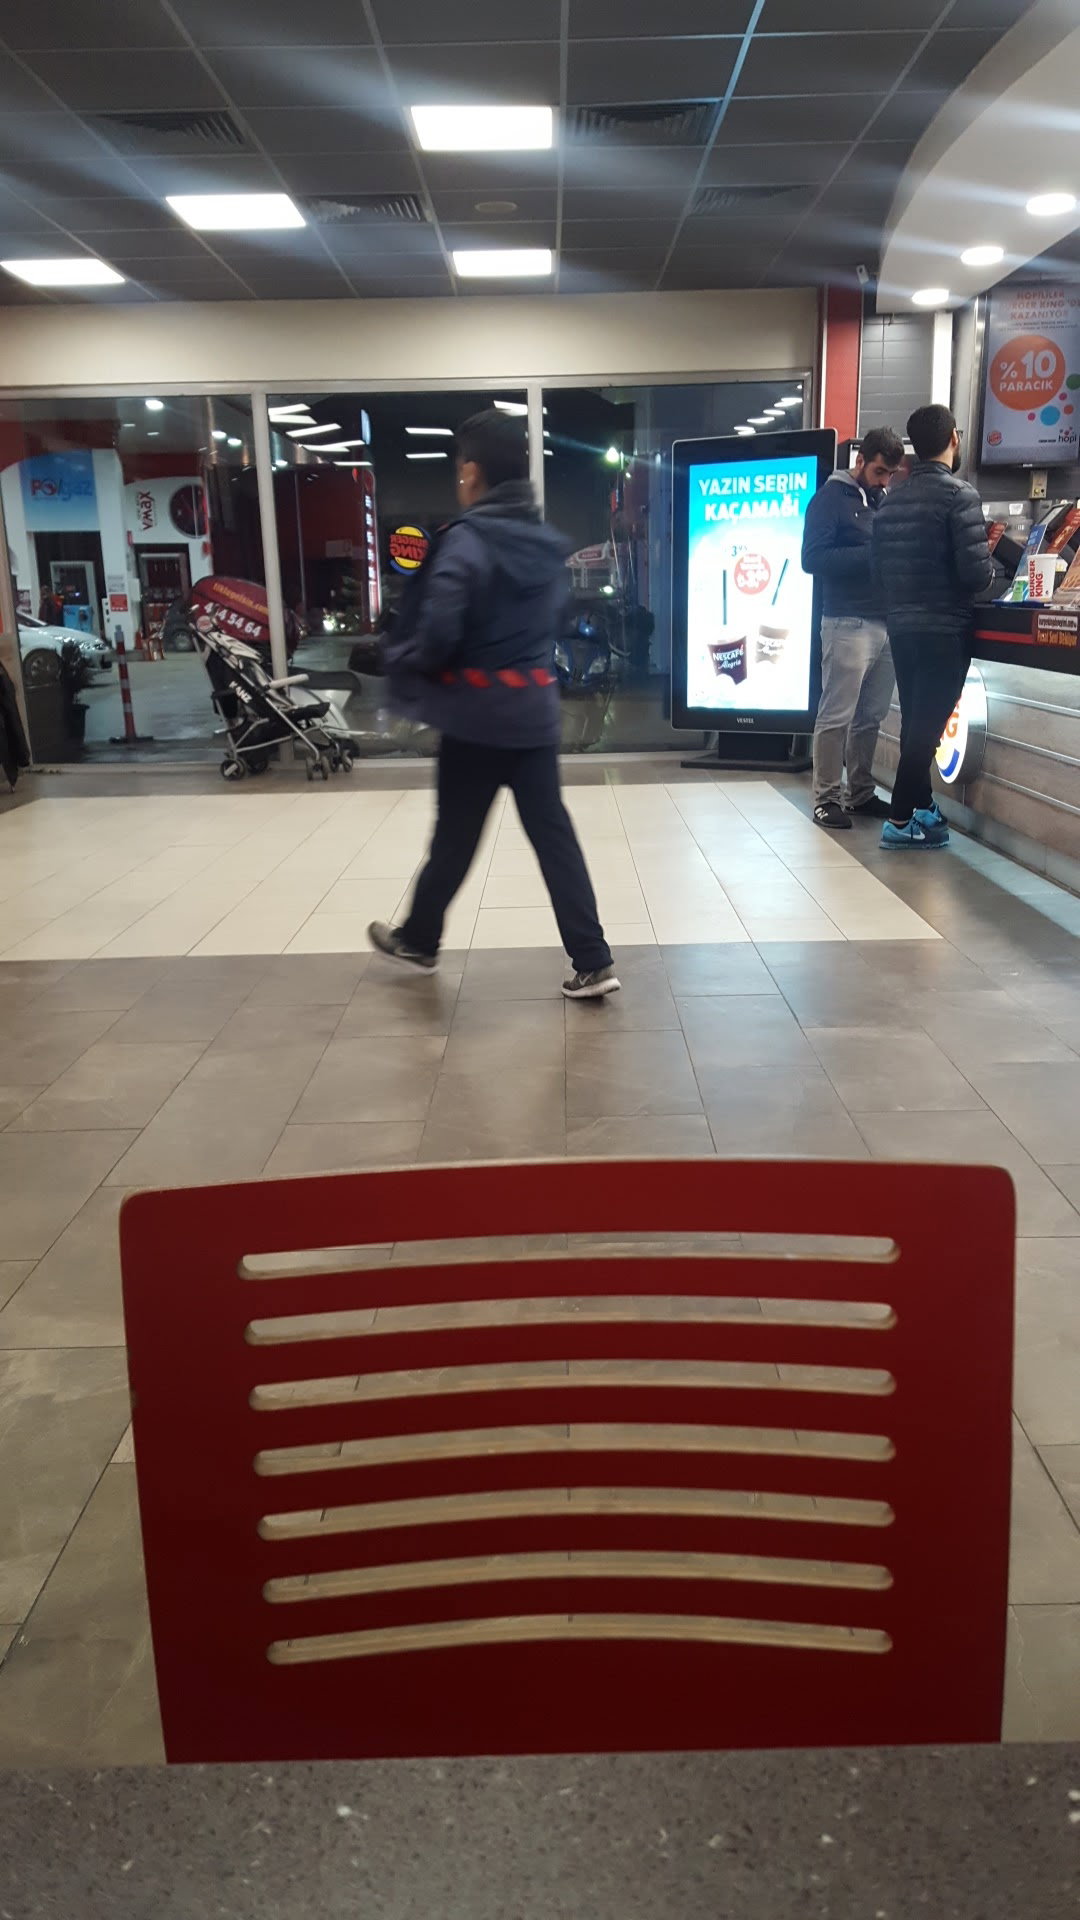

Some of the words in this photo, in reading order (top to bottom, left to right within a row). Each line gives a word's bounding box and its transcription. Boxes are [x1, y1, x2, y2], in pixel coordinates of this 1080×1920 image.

[999, 380, 1053, 392] PARACIK
[698, 476, 751, 497] YAZIN
[1035, 573, 1044, 597] KING
[203, 602, 228, 620] 44
[227, 613, 245, 629] 54
[244, 622, 262, 637] 64
